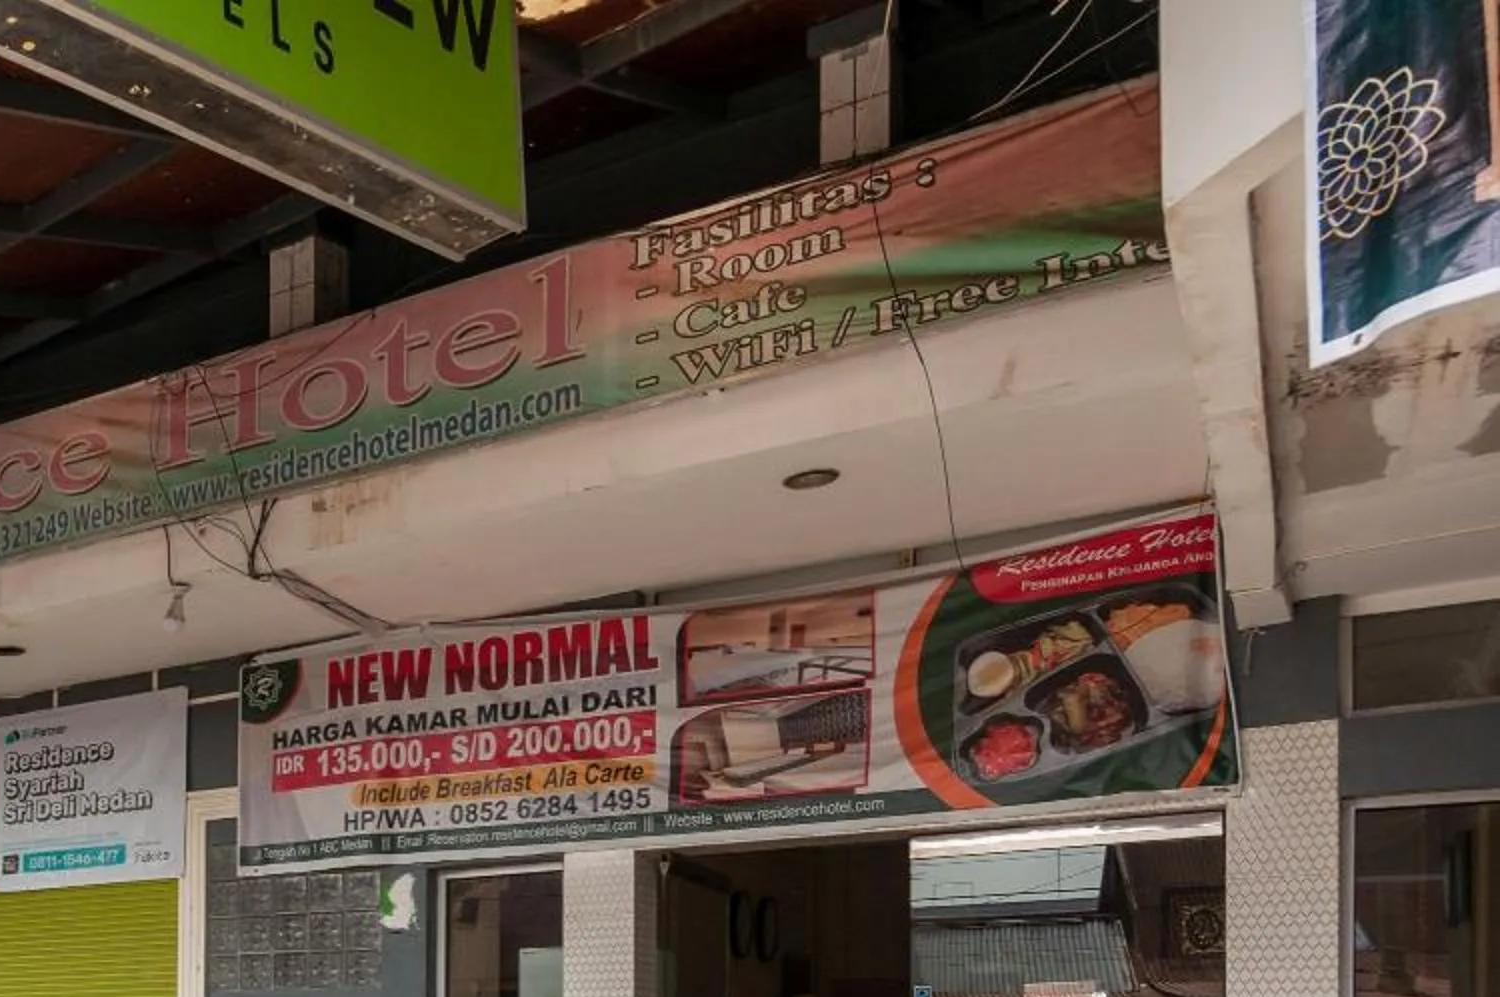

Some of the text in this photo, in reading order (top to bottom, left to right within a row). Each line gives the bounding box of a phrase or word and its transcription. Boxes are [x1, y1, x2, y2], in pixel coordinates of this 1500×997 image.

[630, 167, 892, 270] Fasilitas
[673, 221, 846, 298] Room
[670, 319, 818, 388] WiFi
[869, 272, 1021, 337] Free
[671, 279, 808, 341] Cafe
[155, 253, 590, 473] Hotel
[996, 540, 1134, 577] Residence
[326, 613, 660, 710] NEW NORMAL
[271, 684, 657, 750] HARGA KAMAR MULAI DARI
[274, 715, 654, 777] IDR 135.000,- S/D 200.000,-
[3, 768, 85, 800] Syariah
[4, 741, 115, 774] Residence
[359, 762, 645, 805] Include Breakfast Ala Carte
[3, 788, 153, 825] Sri Deli Medan
[343, 807, 426, 833] HP/WA
[450, 800, 509, 825] 0852
[516, 793, 579, 820] 6284
[587, 786, 652, 814] 1495
[663, 812, 713, 829] Website
